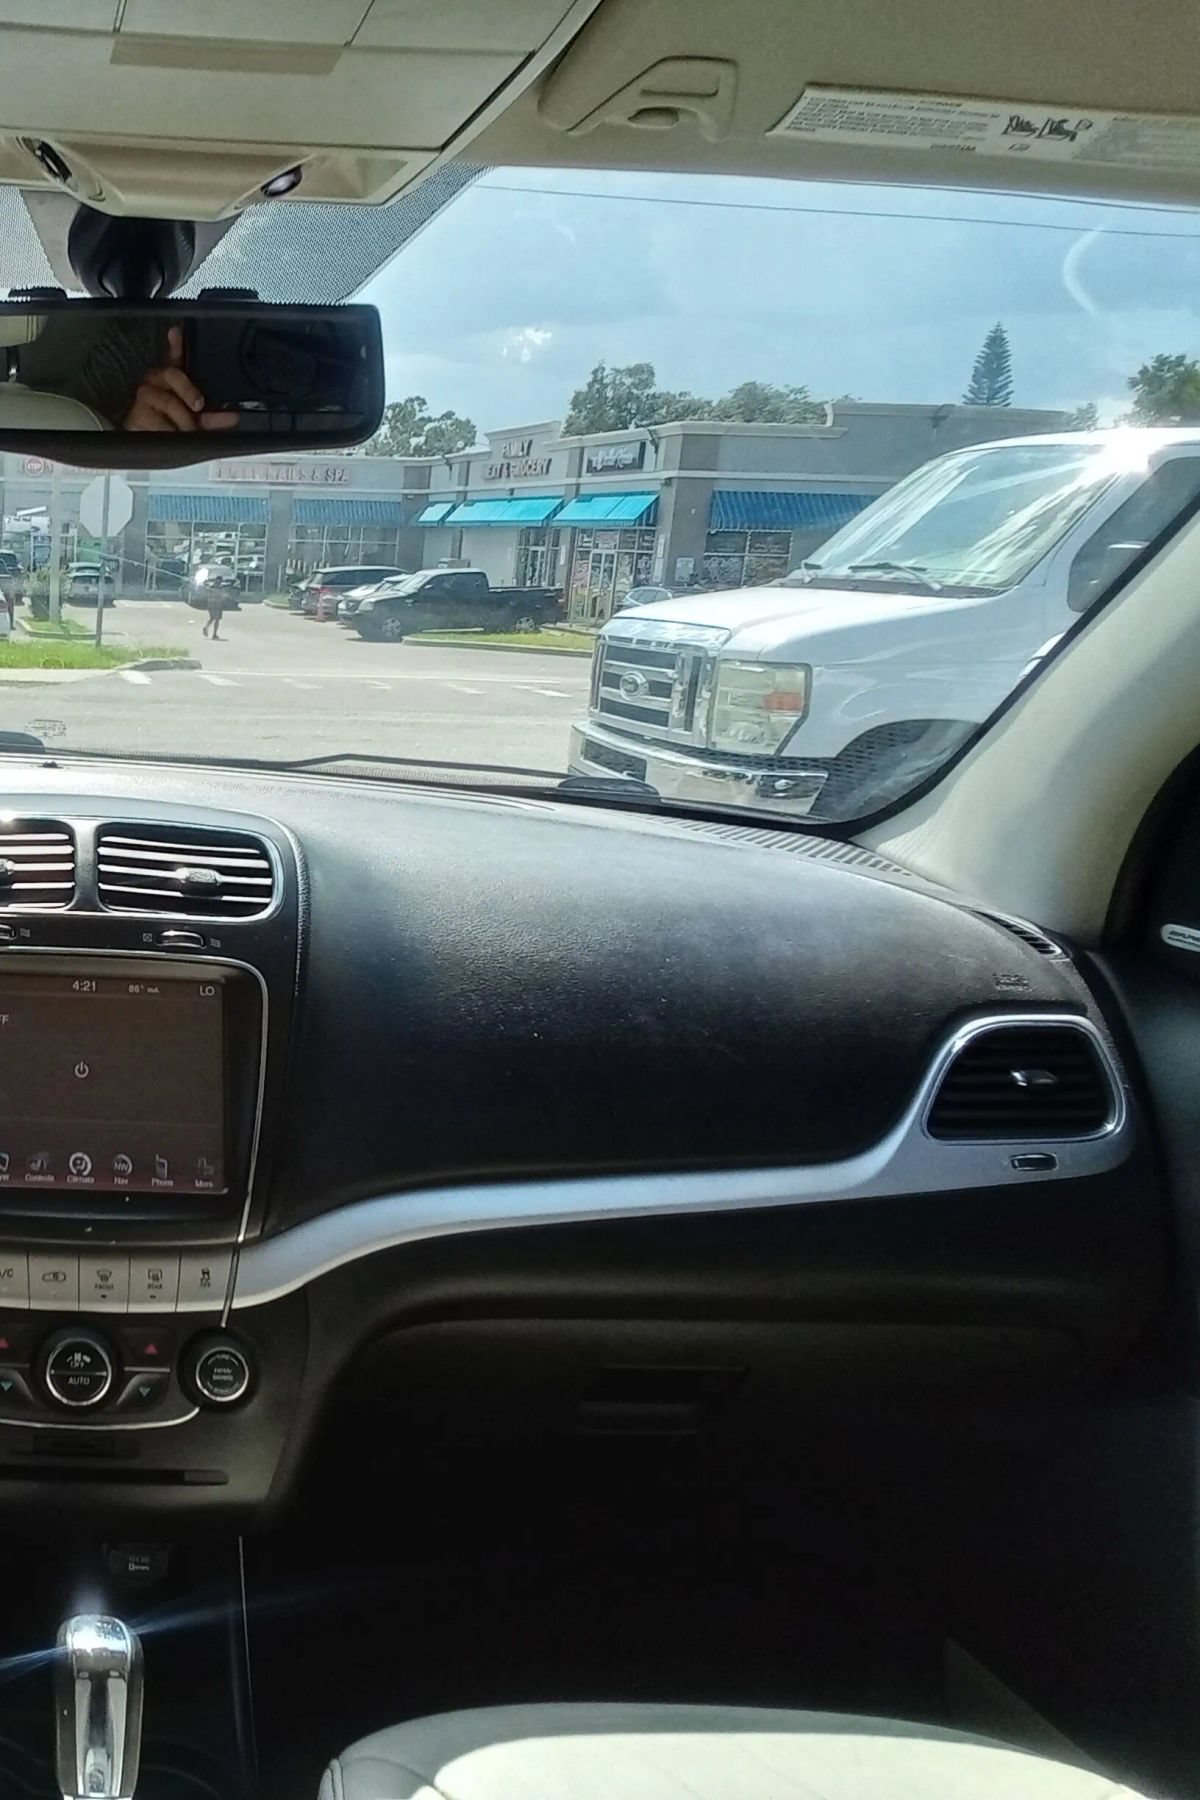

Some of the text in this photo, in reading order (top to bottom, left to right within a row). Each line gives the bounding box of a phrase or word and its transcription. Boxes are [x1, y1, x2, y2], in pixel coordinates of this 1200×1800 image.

[502, 439, 533, 459] FAMILY
[511, 458, 552, 478] GROCERY
[312, 466, 319, 481] &
[325, 467, 349, 482] SPA
[72, 979, 97, 992] 4:21
[199, 985, 215, 997] LO
[24, 1173, 55, 1184] Controls
[66, 1174, 96, 1185] Climate
[113, 1176, 130, 1186] Nav
[151, 1177, 175, 1188] Phone
[67, 1375, 90, 1385] AUTO
